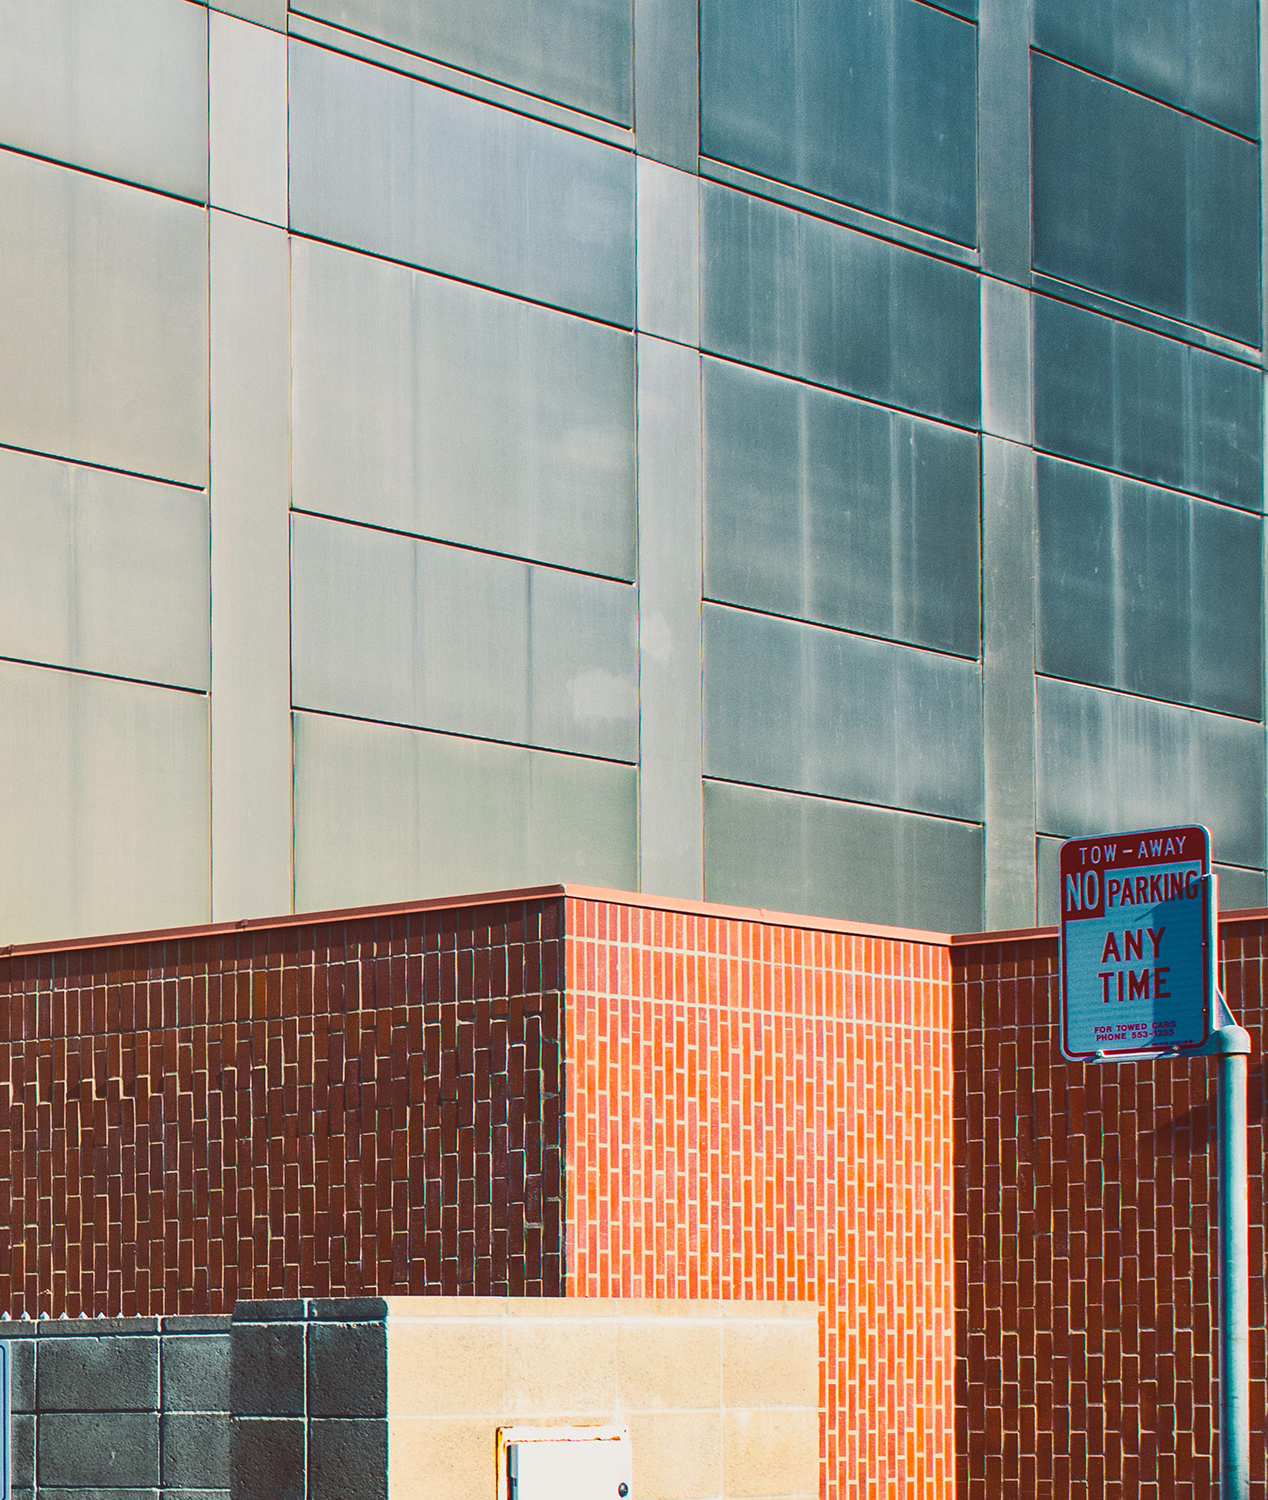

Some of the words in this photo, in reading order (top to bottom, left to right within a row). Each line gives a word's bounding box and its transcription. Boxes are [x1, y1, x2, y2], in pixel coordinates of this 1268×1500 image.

[1065, 869, 1100, 912] NO
[1107, 869, 1199, 908] PARKING
[1101, 926, 1166, 964] ANY
[1098, 966, 1171, 1003] TIME
[1094, 1025, 1112, 1034] FOR
[1116, 1023, 1147, 1032] TOWED
[1151, 1020, 1176, 1030] CARS
[1096, 1032, 1126, 1042] PHONE
[1131, 1029, 1174, 1039] 553-1235
